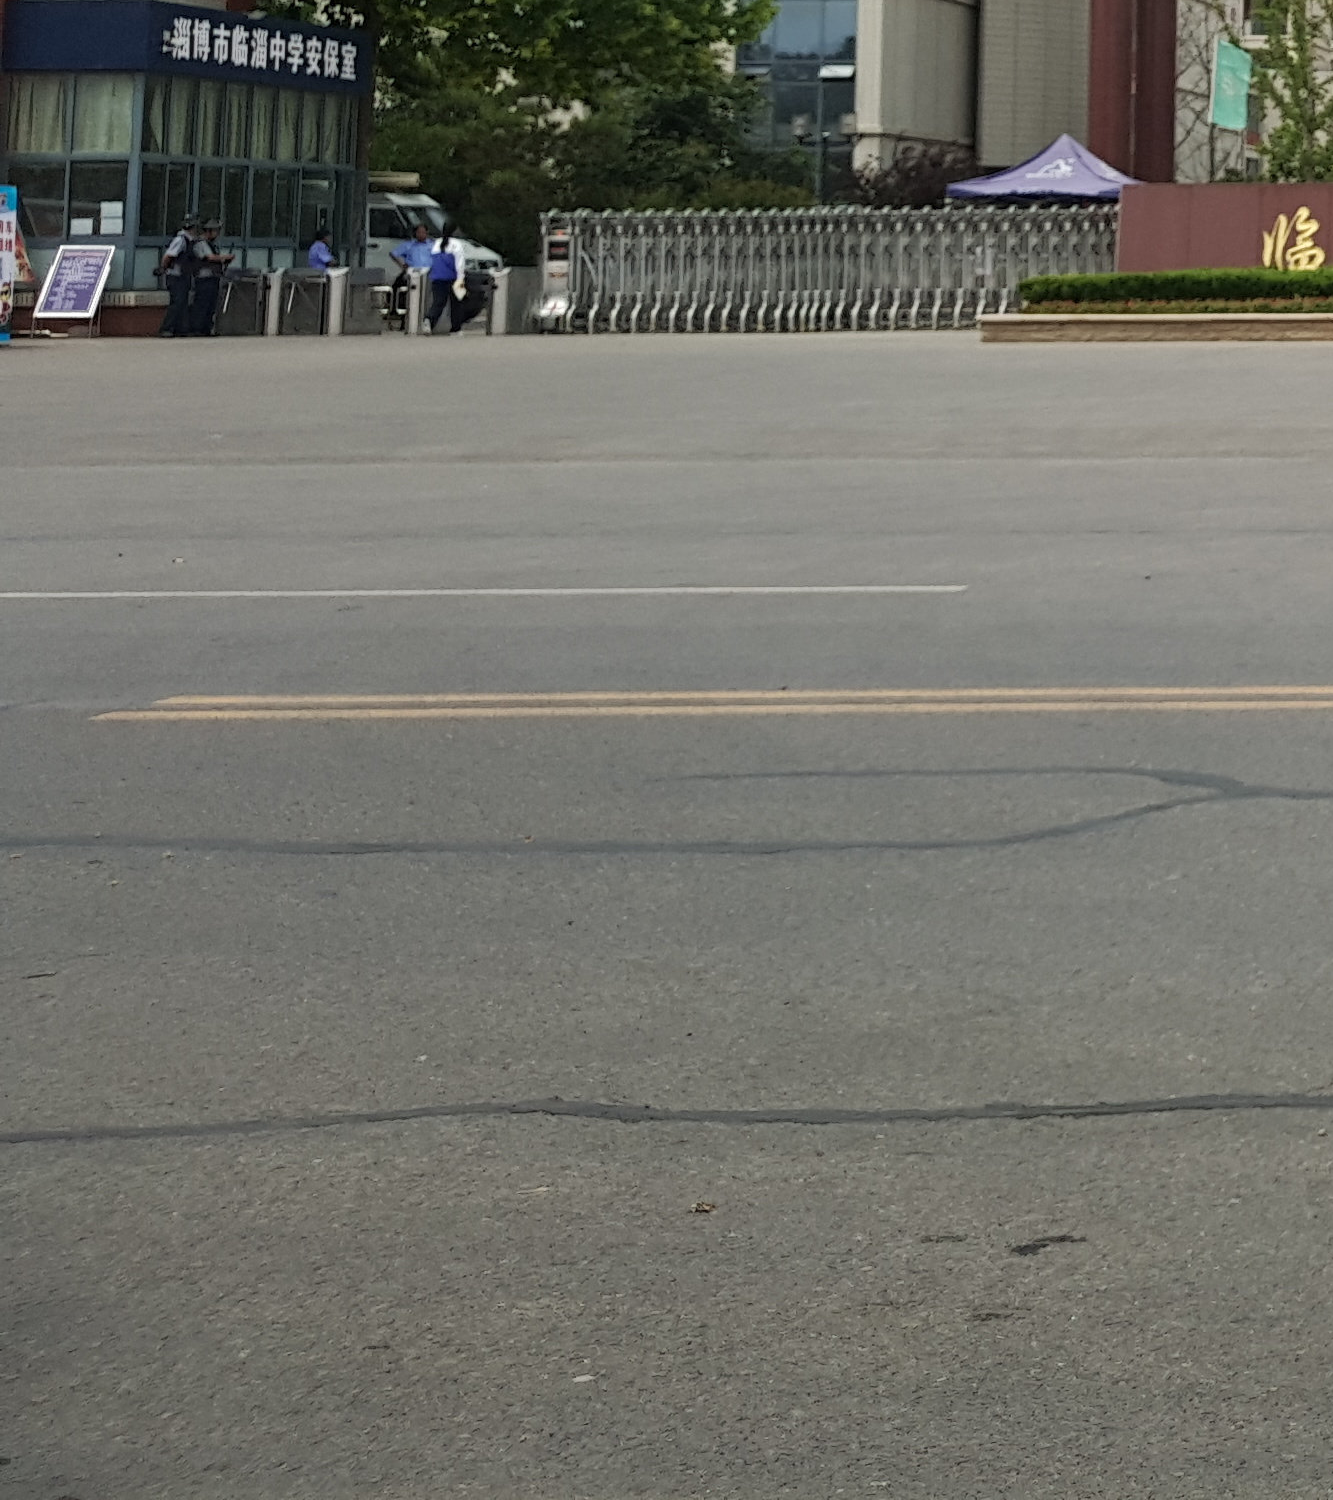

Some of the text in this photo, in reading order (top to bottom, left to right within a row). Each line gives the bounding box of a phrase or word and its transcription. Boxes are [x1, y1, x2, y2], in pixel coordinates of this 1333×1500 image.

[171, 16, 358, 83] 淄博市临淄中学安保室
